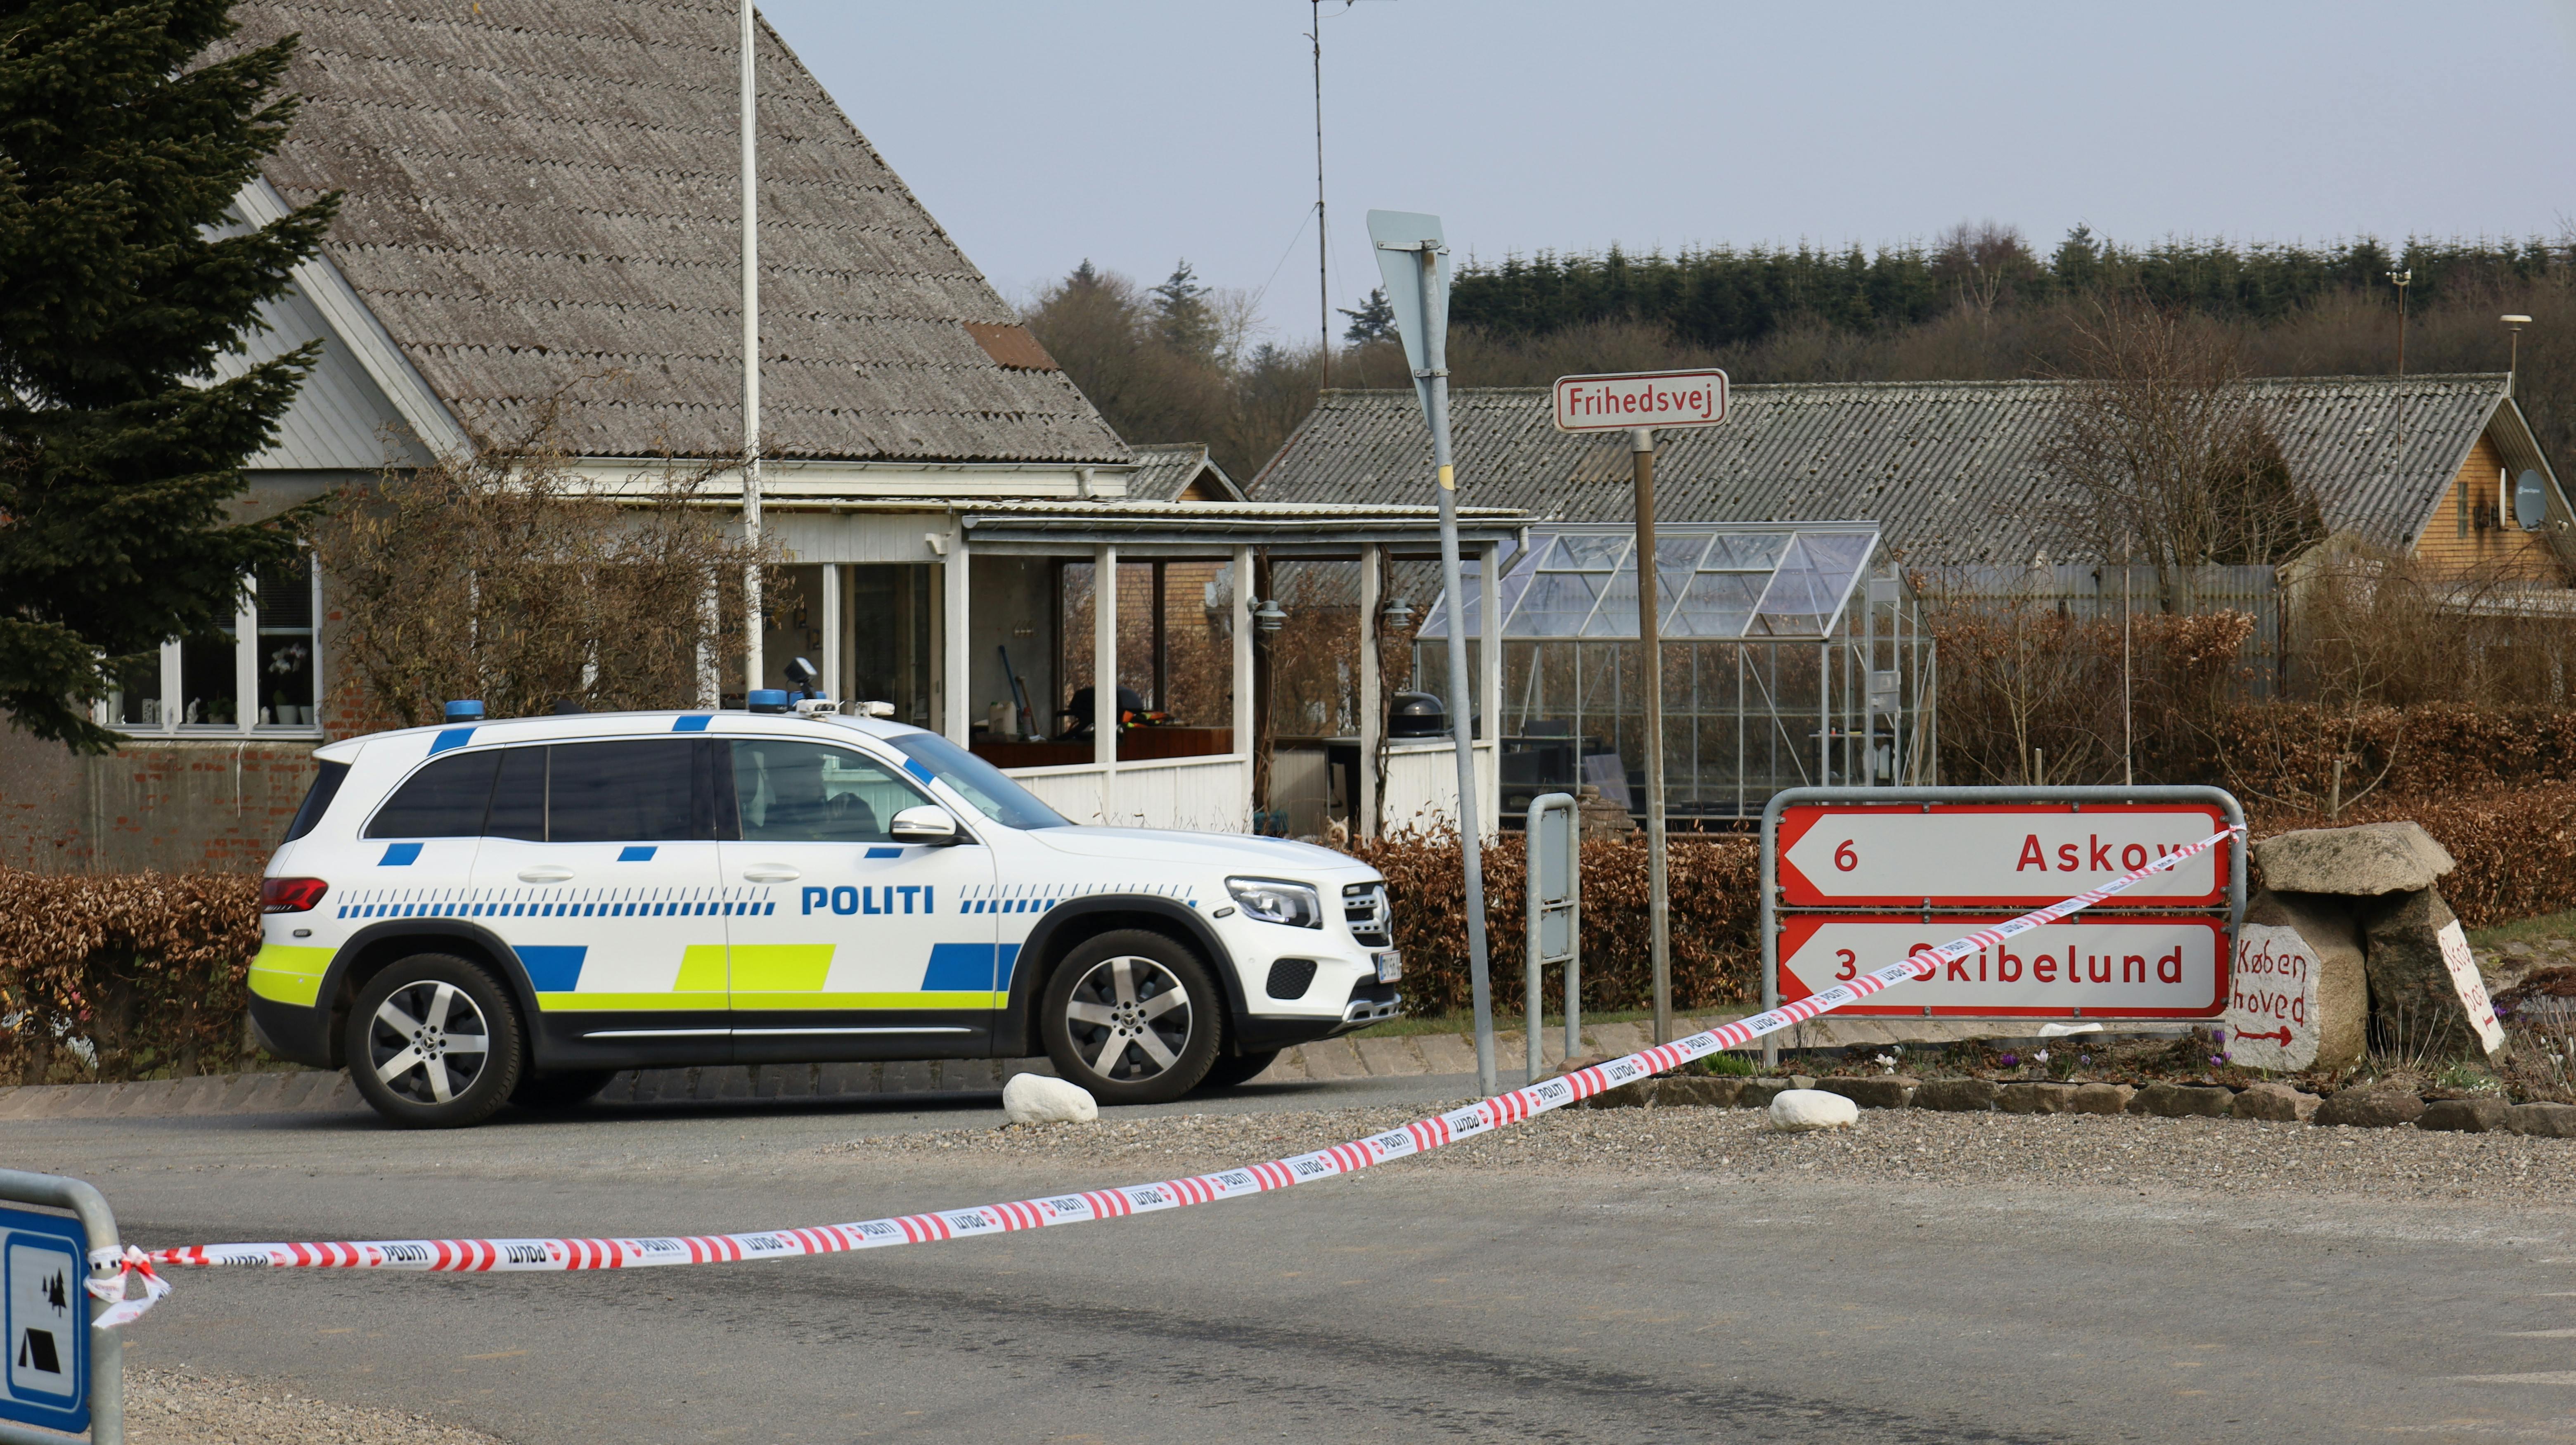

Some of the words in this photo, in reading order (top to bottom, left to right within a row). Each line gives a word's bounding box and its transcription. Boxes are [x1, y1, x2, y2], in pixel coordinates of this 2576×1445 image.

[1570, 384, 1712, 419] Frihedsvej
[1835, 839, 1858, 872] 6
[802, 886, 934, 915] POLITI
[1835, 949, 1856, 981] 3
[2237, 939, 2306, 983] Køben
[1880, 968, 1907, 981] POLITI
[1819, 988, 1847, 1001] POLITI
[2233, 978, 2305, 1028] hoved
[1750, 1016, 1777, 1030] POLITI
[1685, 1035, 1714, 1049] POLITI
[1609, 1063, 1636, 1081] POLITI
[1537, 1082, 1566, 1100] POLITI
[1453, 1114, 1480, 1134] POLITI
[1378, 1133, 1409, 1149] POLITI
[1293, 1160, 1324, 1176] POLITI
[1219, 1172, 1250, 1186] POLITI
[1050, 1198, 1084, 1212] POLITI
[1131, 1190, 1163, 1206] POLITI
[857, 1222, 896, 1236] POLITI
[951, 1215, 987, 1229] POLITI
[638, 1240, 681, 1251] POLITI
[742, 1236, 783, 1251] POLITI
[382, 1245, 428, 1262] POLITI
[504, 1246, 547, 1264] POLITI
